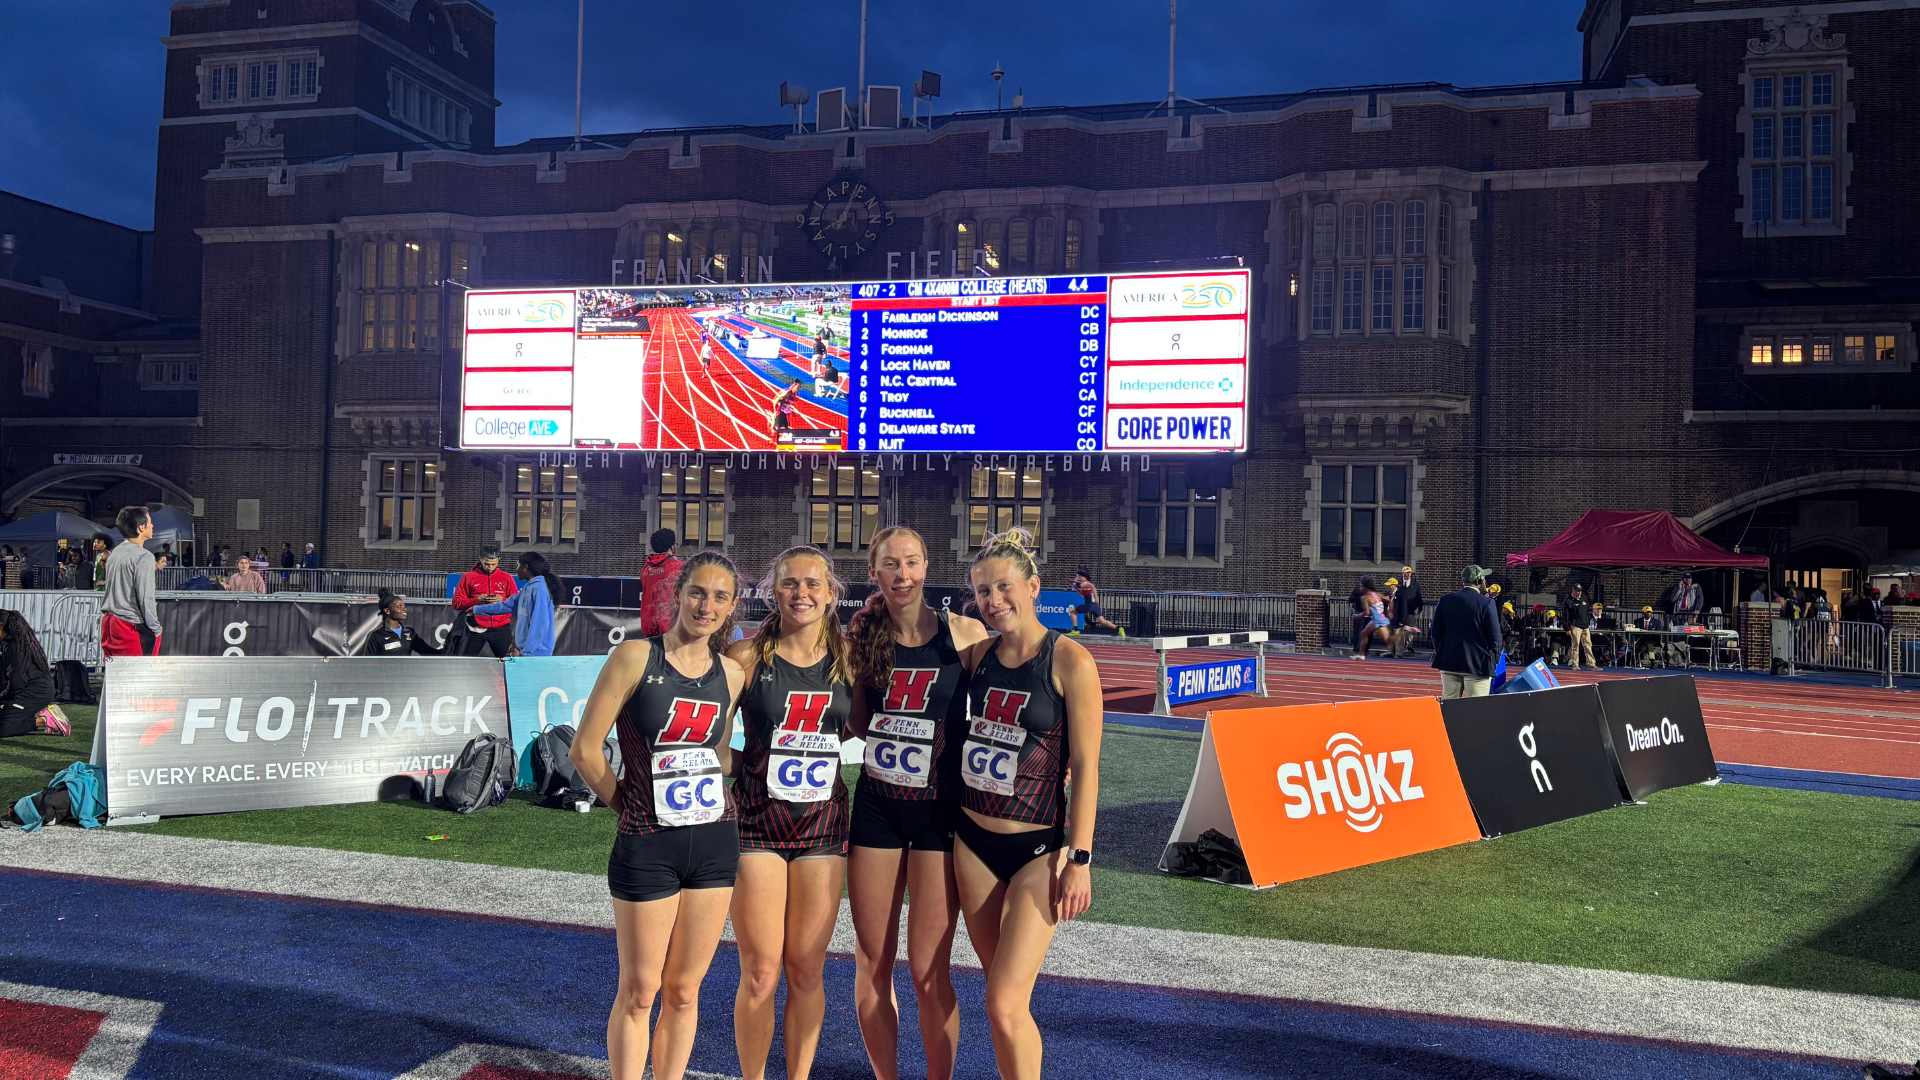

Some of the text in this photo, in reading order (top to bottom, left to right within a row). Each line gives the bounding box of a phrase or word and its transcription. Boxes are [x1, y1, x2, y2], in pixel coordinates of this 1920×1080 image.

[611, 249, 986, 286] FRANKLIN FIELD
[858, 284, 880, 297] 407
[888, 284, 896, 297] 2
[961, 280, 1007, 295] COLLEGE
[1008, 278, 1047, 296] (HEATS)
[1068, 278, 1089, 292] 4.4
[1121, 282, 1237, 309] AMERICA 250
[524, 300, 567, 323] 250
[862, 305, 1099, 324] 1 FAIRLEIGH DICKINSON DC
[861, 323, 1099, 340] 2 MONROE CB
[861, 339, 1099, 356] 3 FORDHAM DB
[860, 355, 1098, 371] 4 LOCK HAVEN CY
[860, 372, 1097, 387] 5 N.C. CENTRAL CT
[1119, 378, 1215, 393] Independence
[859, 388, 1097, 403] 6 TROY CA
[859, 405, 1096, 418] 7 BUCKNELL CF
[475, 417, 552, 439] College AVE
[858, 421, 1097, 434] 8 DELAWARE STATE CK
[1118, 416, 1232, 440] CORE POWER
[858, 438, 1096, 450] 9 NJIT CO
[540, 452, 1151, 472] ROBERT WOOD JOHNSON FAMILY SCOREBOARD
[883, 668, 940, 713] H
[1178, 664, 1242, 697] PENN RELAYS
[780, 691, 834, 732] H
[983, 687, 1032, 726] H
[180, 696, 295, 744] FLO
[327, 695, 492, 739] TRACK
[654, 697, 721, 747] H
[894, 719, 921, 728] PENN
[991, 723, 1014, 733] PENN
[892, 726, 927, 736] RELAYS
[989, 730, 1020, 743] RELAYS
[1626, 717, 1684, 752] Dream On.
[874, 741, 923, 773] GC
[967, 746, 1011, 780] GC
[127, 766, 198, 787] EVERY
[202, 764, 261, 783] RACE.
[265, 760, 329, 779] EVERY
[777, 759, 829, 787] GC
[665, 777, 718, 811] GC
[1277, 748, 1425, 820] SHOKZ
